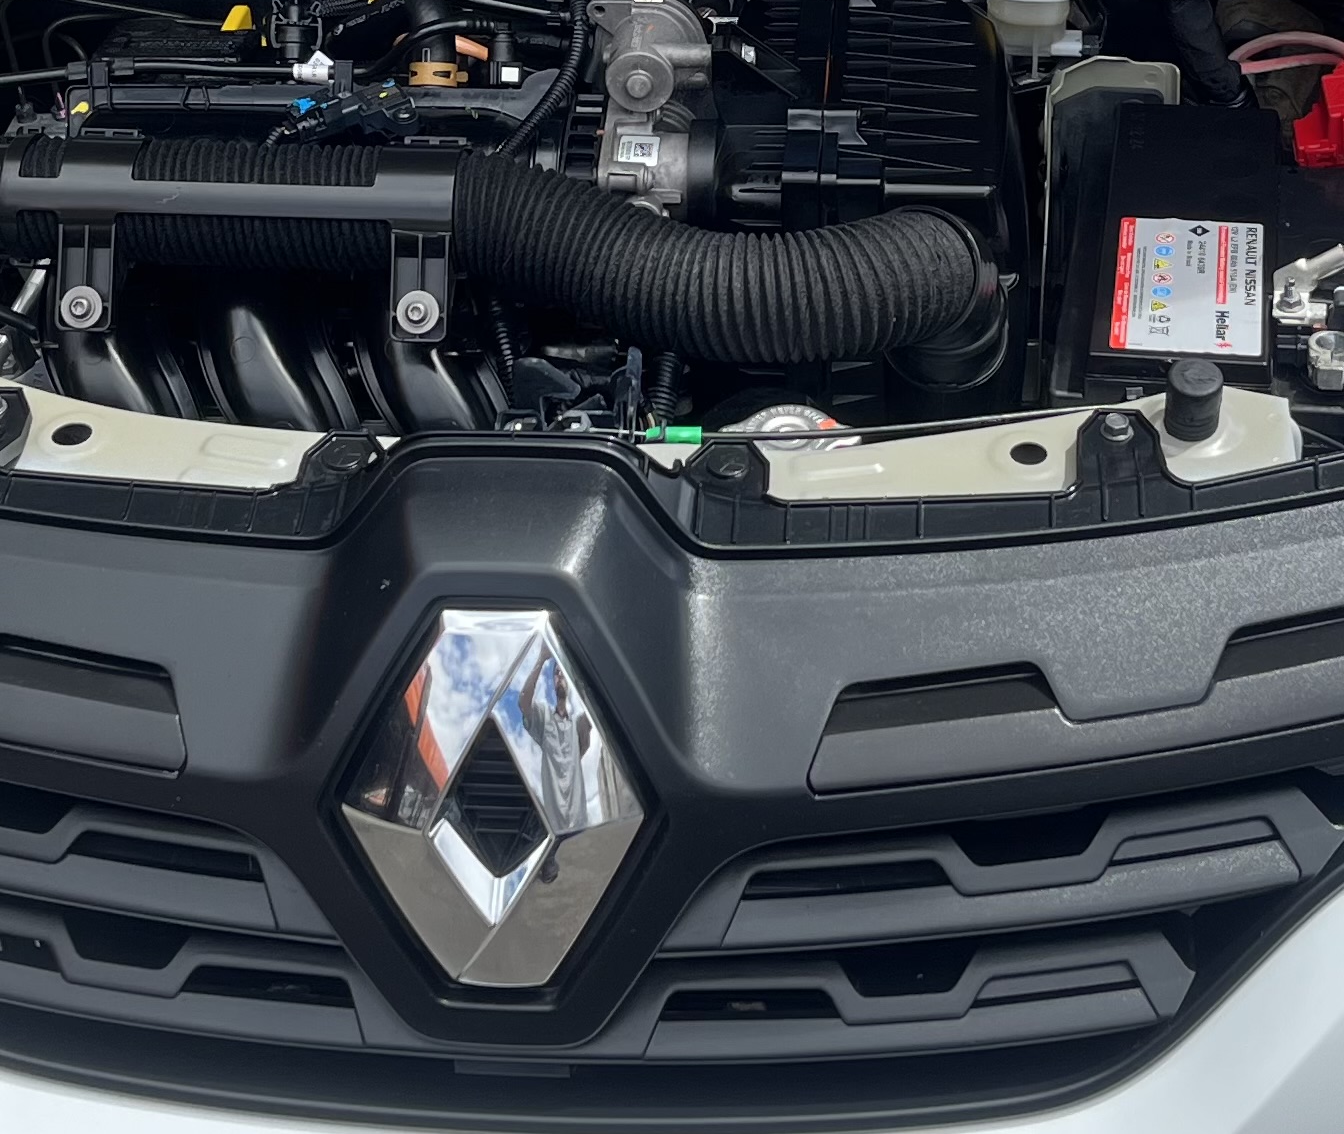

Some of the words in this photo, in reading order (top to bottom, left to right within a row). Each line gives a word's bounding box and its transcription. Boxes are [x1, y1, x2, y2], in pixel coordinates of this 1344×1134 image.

[1245, 227, 1258, 266] RENAULT
[1244, 269, 1257, 306] NISSAN
[1215, 310, 1230, 341] Heliar
